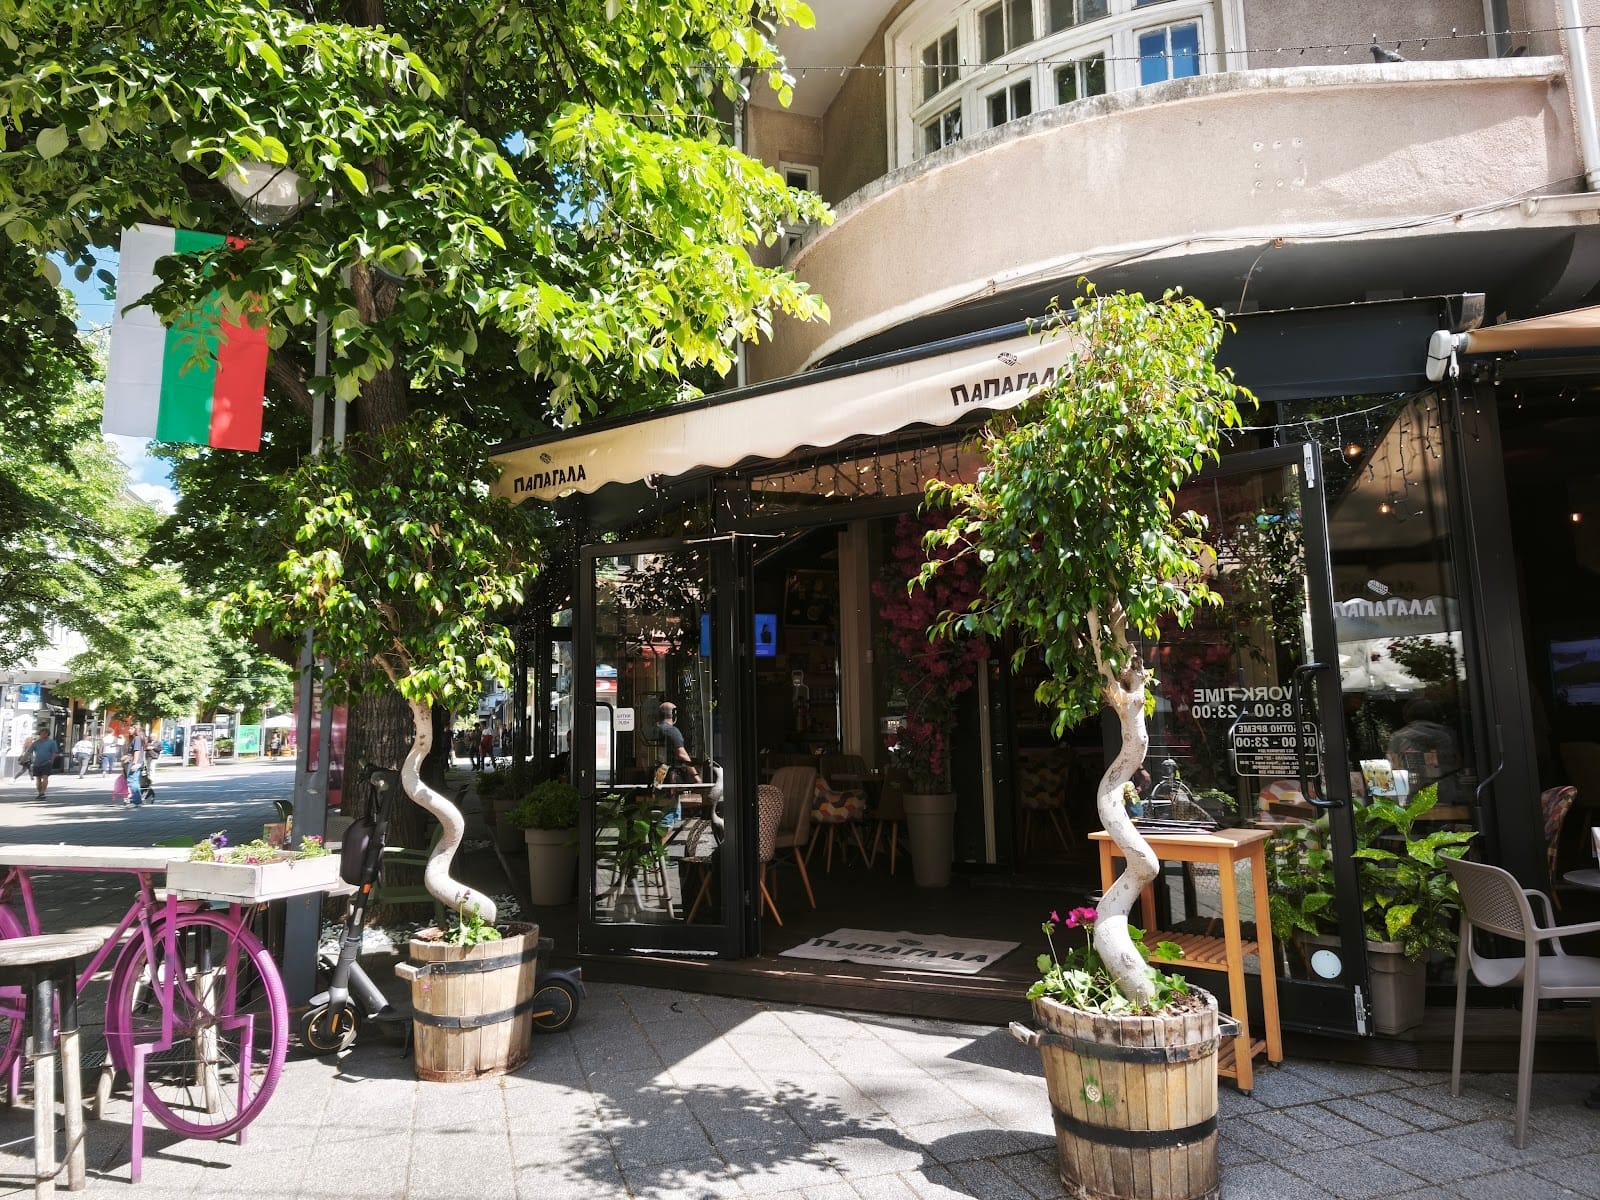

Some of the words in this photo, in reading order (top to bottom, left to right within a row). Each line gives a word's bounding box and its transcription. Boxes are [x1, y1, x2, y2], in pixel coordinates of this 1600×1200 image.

[950, 364, 1070, 406] ПАПАГАЛ
[513, 464, 587, 494] ПАПАГАЛА
[1333, 598, 1438, 618] ПАПАГАЛА
[812, 938, 989, 963] ПАПАГАЛА
